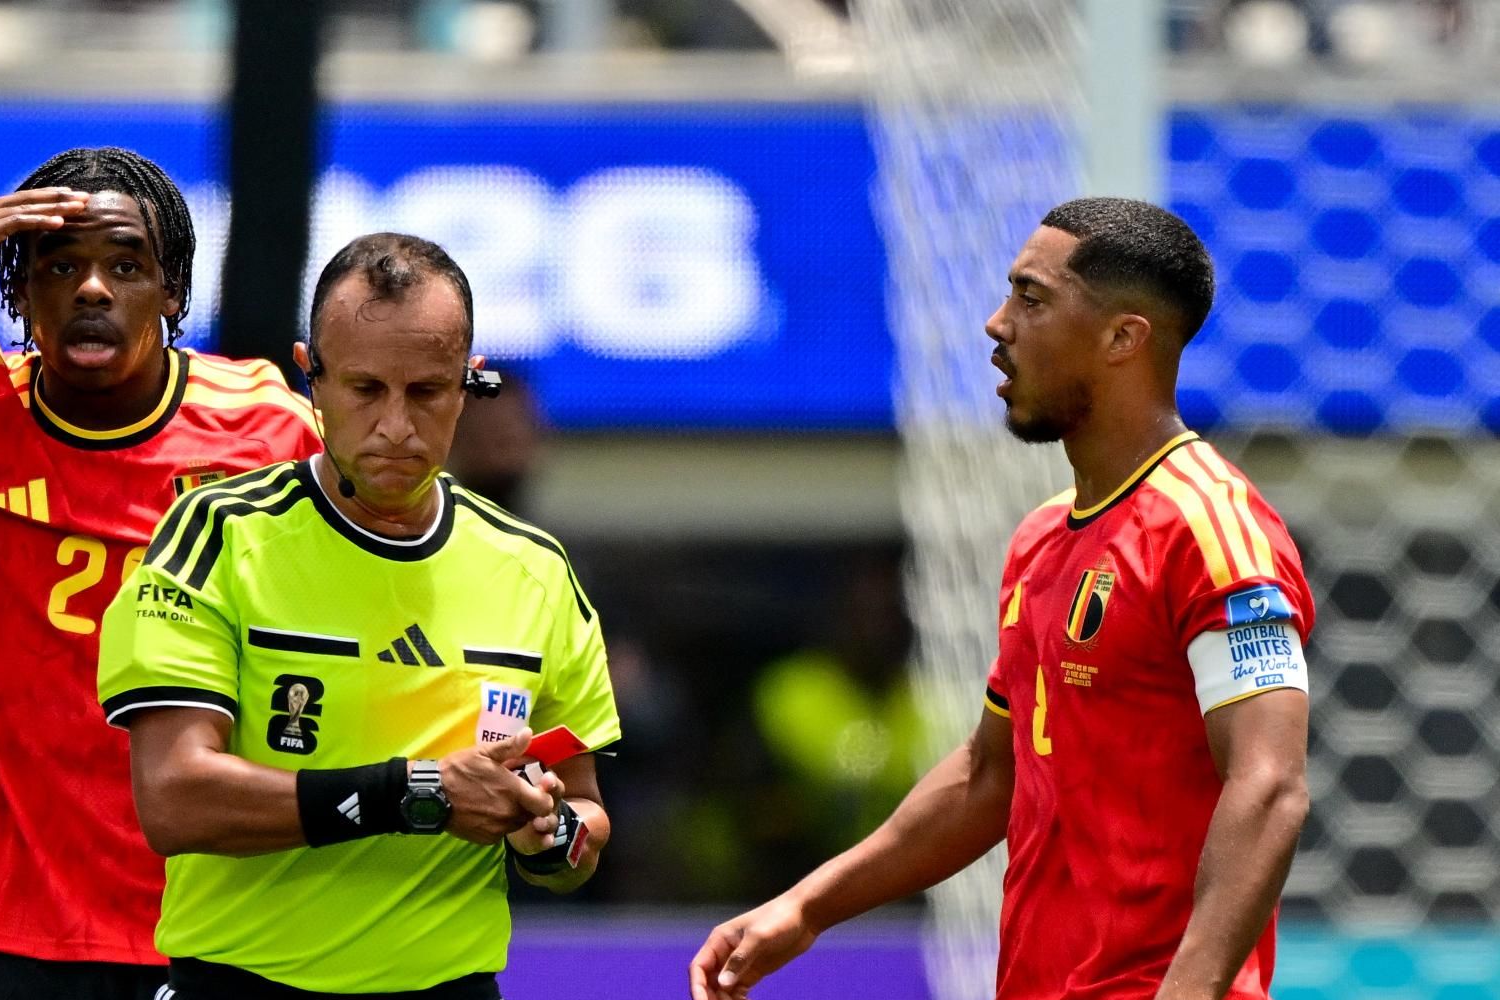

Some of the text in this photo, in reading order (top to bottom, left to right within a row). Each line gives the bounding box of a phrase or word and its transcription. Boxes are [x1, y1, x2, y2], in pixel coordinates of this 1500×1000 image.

[136, 583, 194, 610] FIFA
[135, 609, 195, 624] TEAM ONE
[1227, 624, 1289, 646] FOOTBALL
[1230, 639, 1292, 663] UNITES
[1231, 663, 1257, 681] the
[1257, 675, 1283, 688] FIFA
[487, 688, 528, 720] FIFA
[280, 736, 305, 749] FIFA
